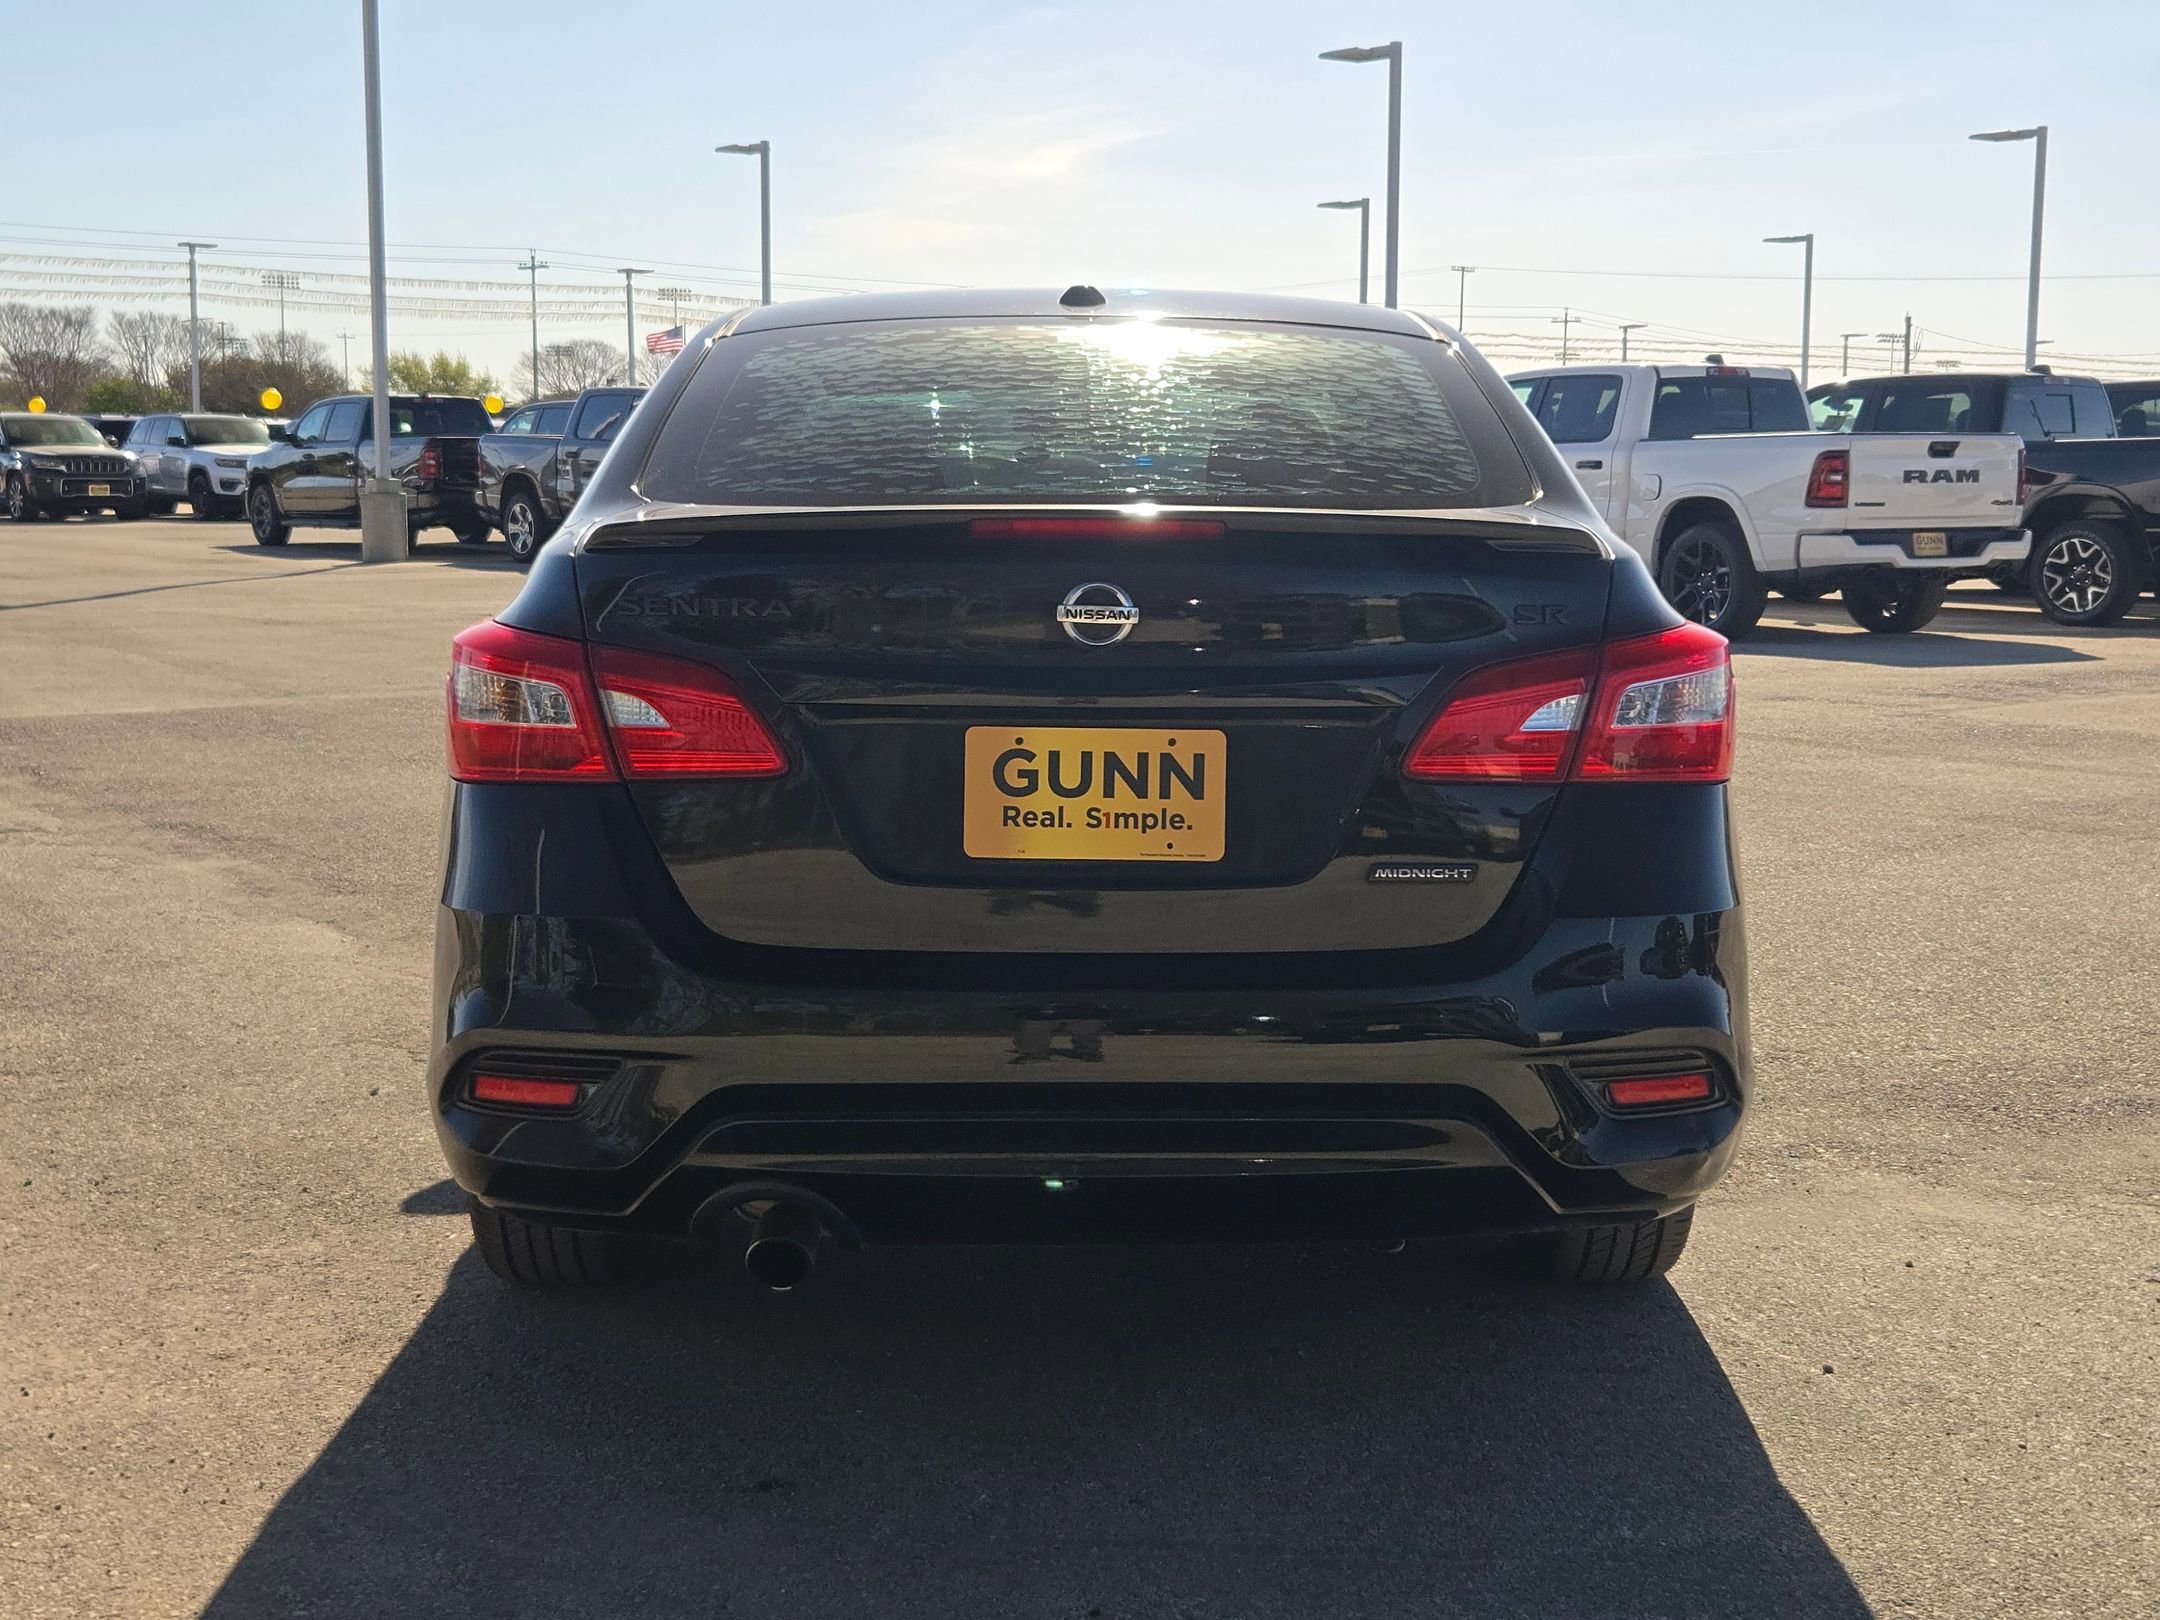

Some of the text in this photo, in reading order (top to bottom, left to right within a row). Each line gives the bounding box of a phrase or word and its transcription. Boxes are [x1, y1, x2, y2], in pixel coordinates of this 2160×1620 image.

[1903, 469, 1980, 484] RAM
[1916, 536, 1943, 545] GUNN
[617, 597, 793, 617] SENTRA
[1065, 608, 1131, 621] NISSAN
[1512, 604, 1569, 624] SR
[992, 747, 1206, 801] GUNN
[1002, 805, 1073, 829] Real.
[1375, 868, 1473, 878] MIDNIGHT
